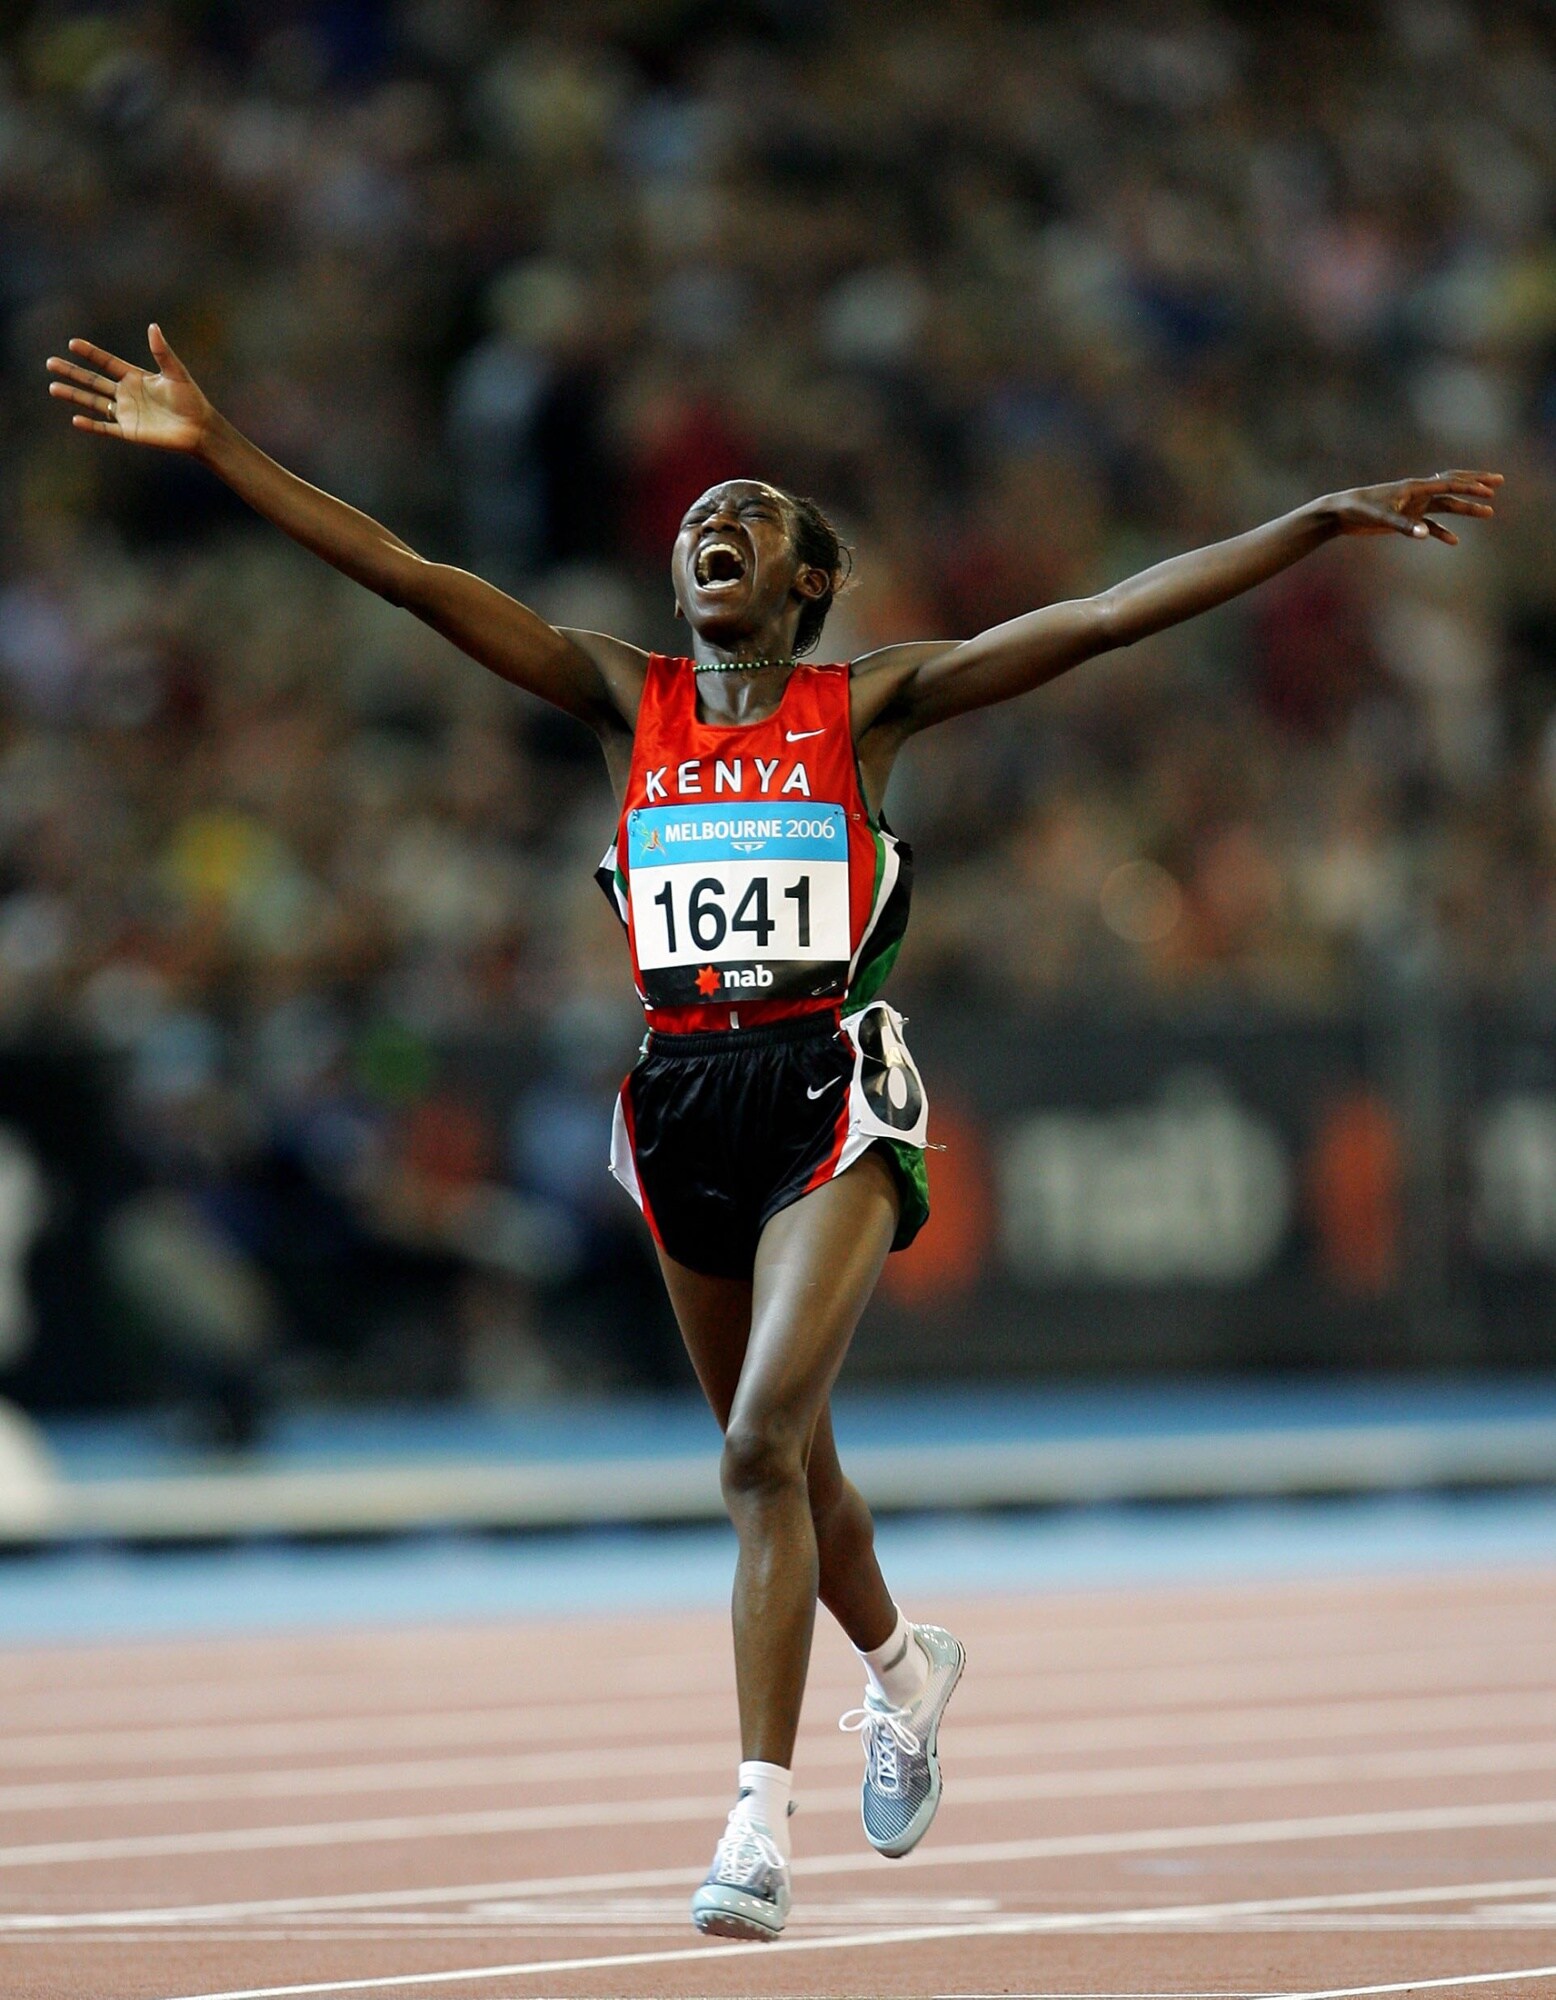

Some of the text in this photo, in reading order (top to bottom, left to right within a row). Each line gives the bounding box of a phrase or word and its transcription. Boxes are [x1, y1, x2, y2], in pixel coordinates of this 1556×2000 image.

[645, 758, 811, 802] KENYA
[664, 817, 835, 842] MELBOURNE 2006
[654, 875, 811, 953] 1641
[723, 964, 773, 988] nab
